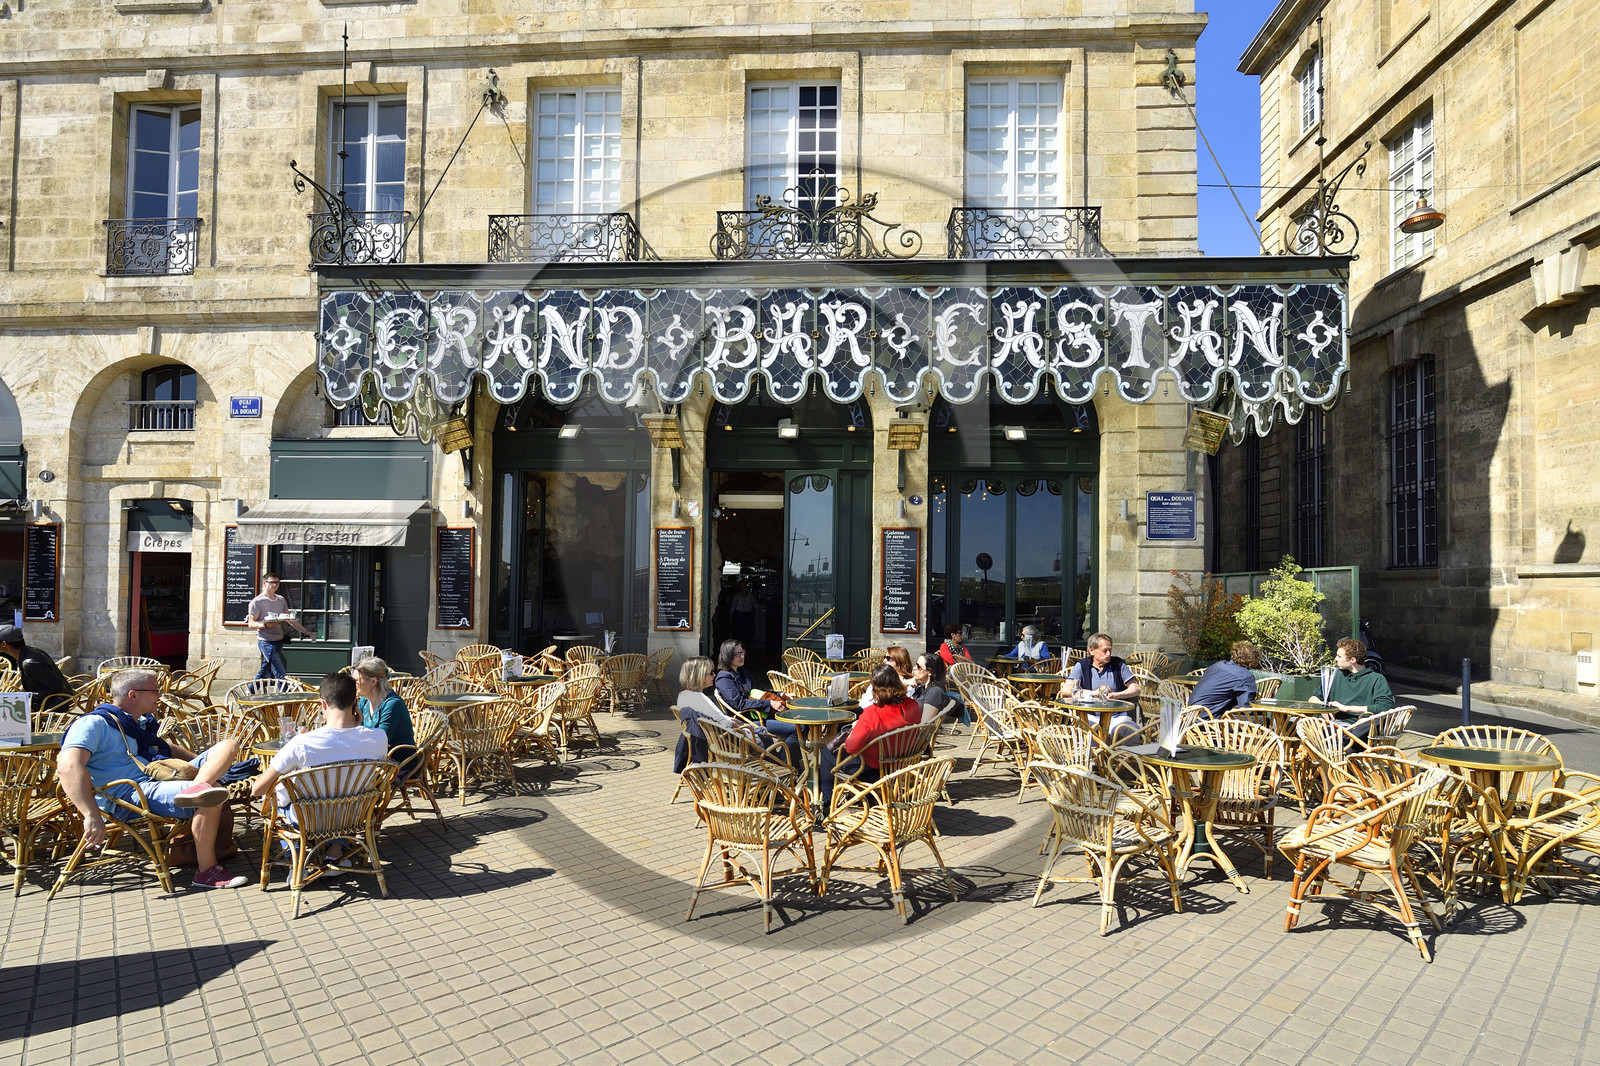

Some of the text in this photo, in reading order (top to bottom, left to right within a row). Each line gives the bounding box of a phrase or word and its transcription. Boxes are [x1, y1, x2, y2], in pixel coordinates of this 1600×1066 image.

[374, 298, 1285, 371] GRAND BAR CASTAN
[913, 496, 919, 504] 2
[144, 535, 183, 550] Crêpes
[278, 526, 362, 543] du Castan
